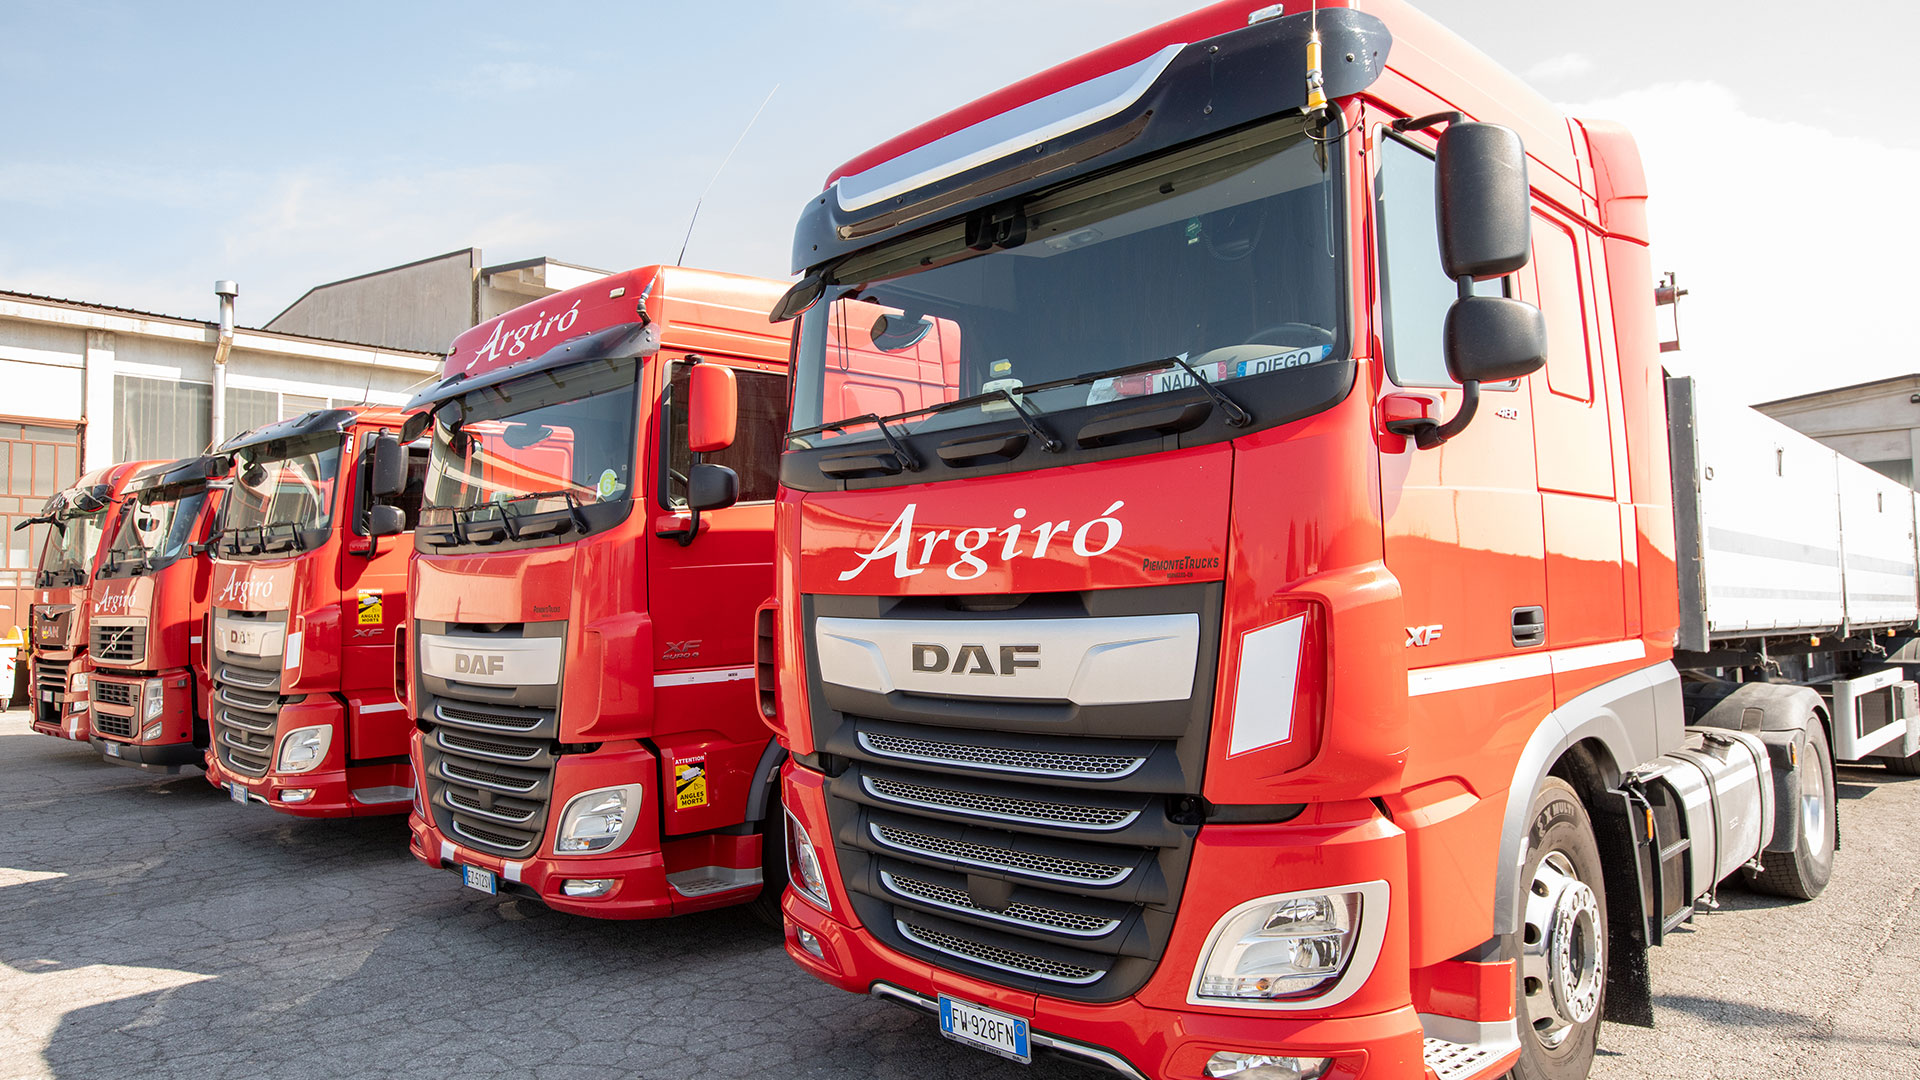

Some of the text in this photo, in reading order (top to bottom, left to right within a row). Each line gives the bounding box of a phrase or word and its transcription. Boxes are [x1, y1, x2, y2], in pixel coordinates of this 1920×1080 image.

[465, 299, 582, 370] Argiró
[1256, 351, 1311, 375] DIEGO
[838, 500, 1125, 581] Argiró
[219, 568, 275, 604] Argiró
[352, 628, 385, 638] XF
[1405, 624, 1443, 647] XF
[664, 639, 703, 655] XF
[455, 653, 504, 676] DAF
[912, 643, 1041, 677] DAF
[674, 755, 705, 765] ATTENTION
[680, 790, 704, 801] ANGLES
[681, 797, 704, 806] MORTS
[1552, 801, 1575, 816] MULTI
